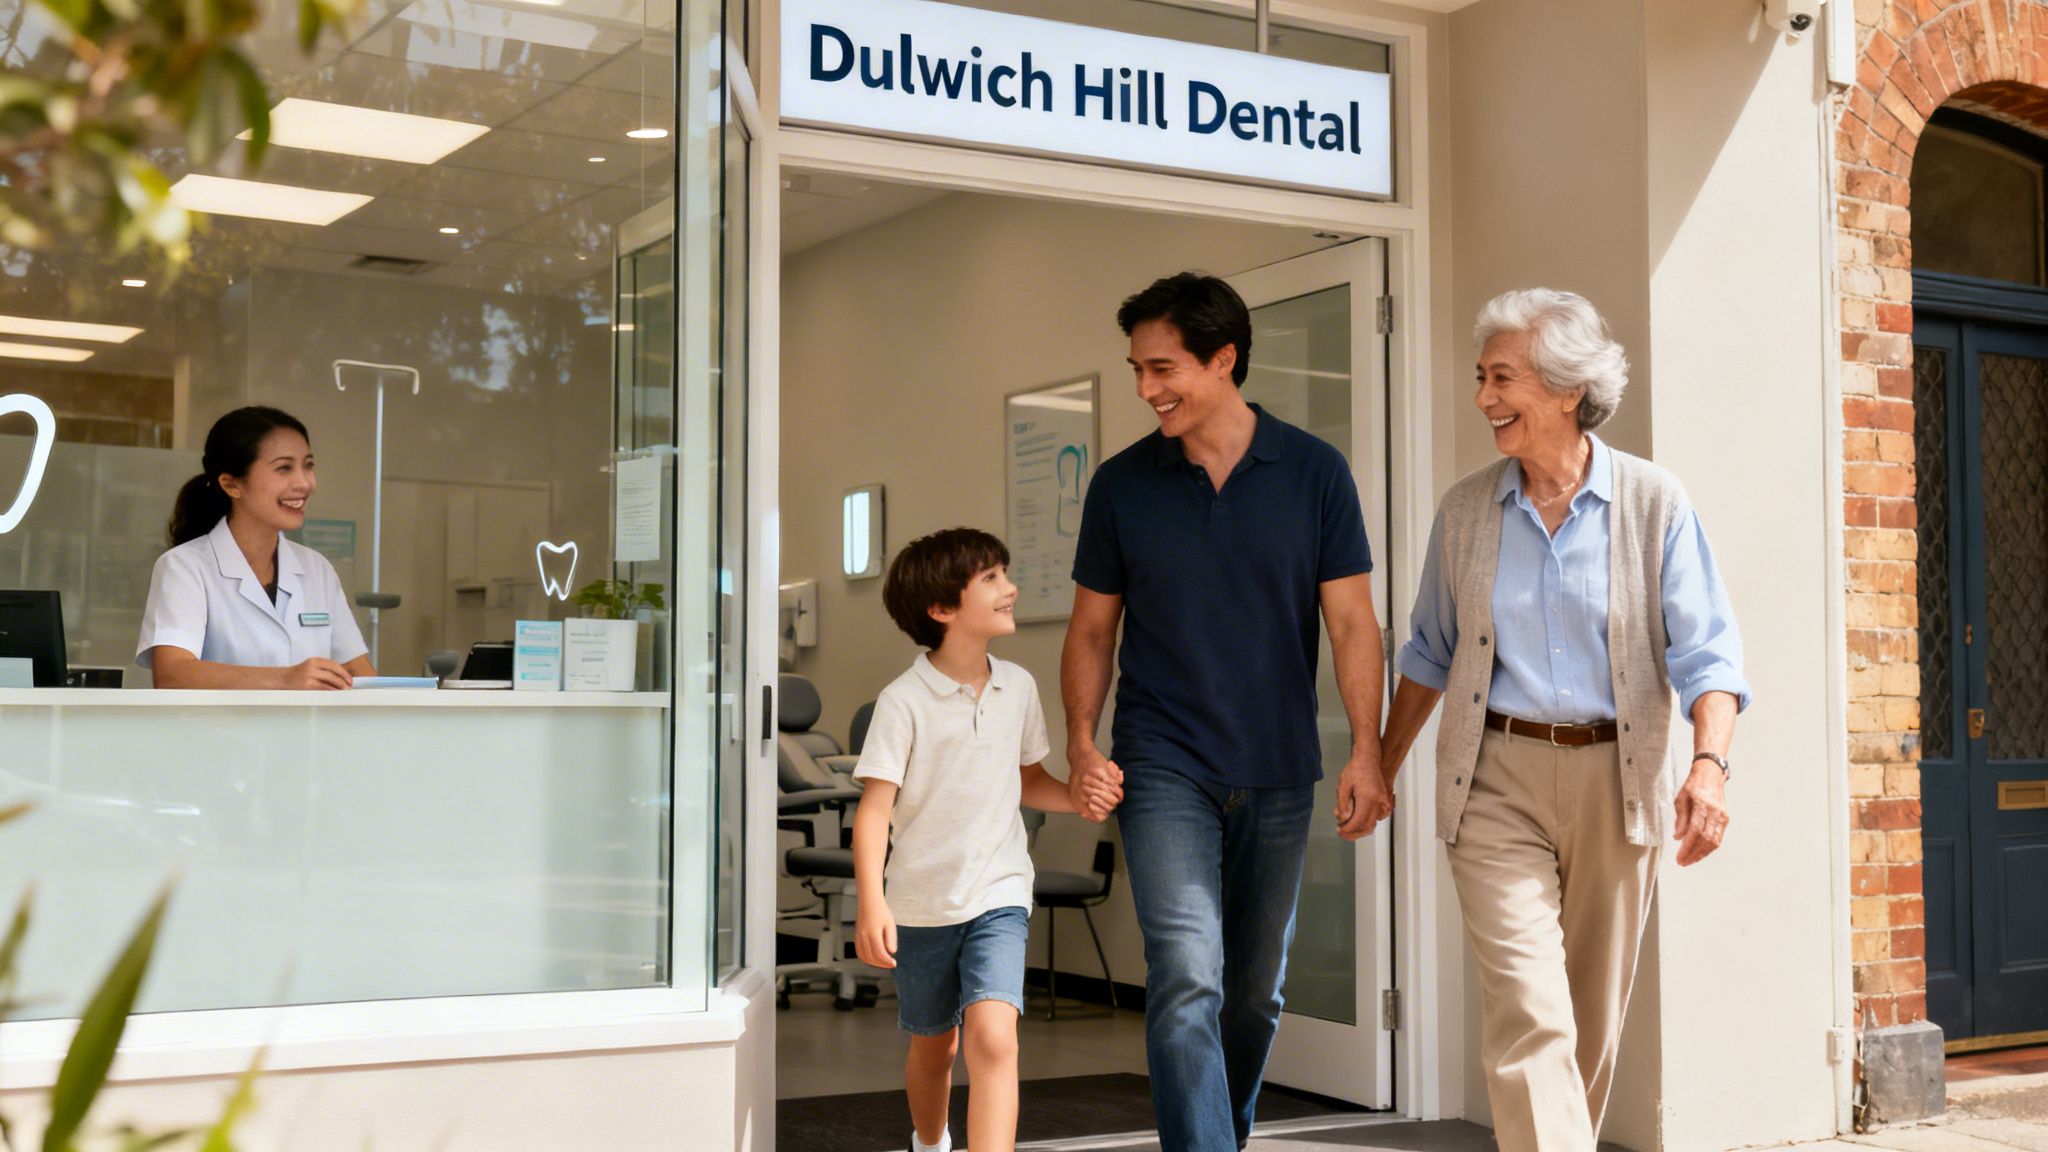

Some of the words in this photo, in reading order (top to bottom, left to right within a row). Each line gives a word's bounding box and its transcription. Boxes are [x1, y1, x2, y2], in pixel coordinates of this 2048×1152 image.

[810, 23, 1053, 112] Dulwich
[1074, 64, 1168, 130] Hill
[1188, 79, 1362, 155] Dental
